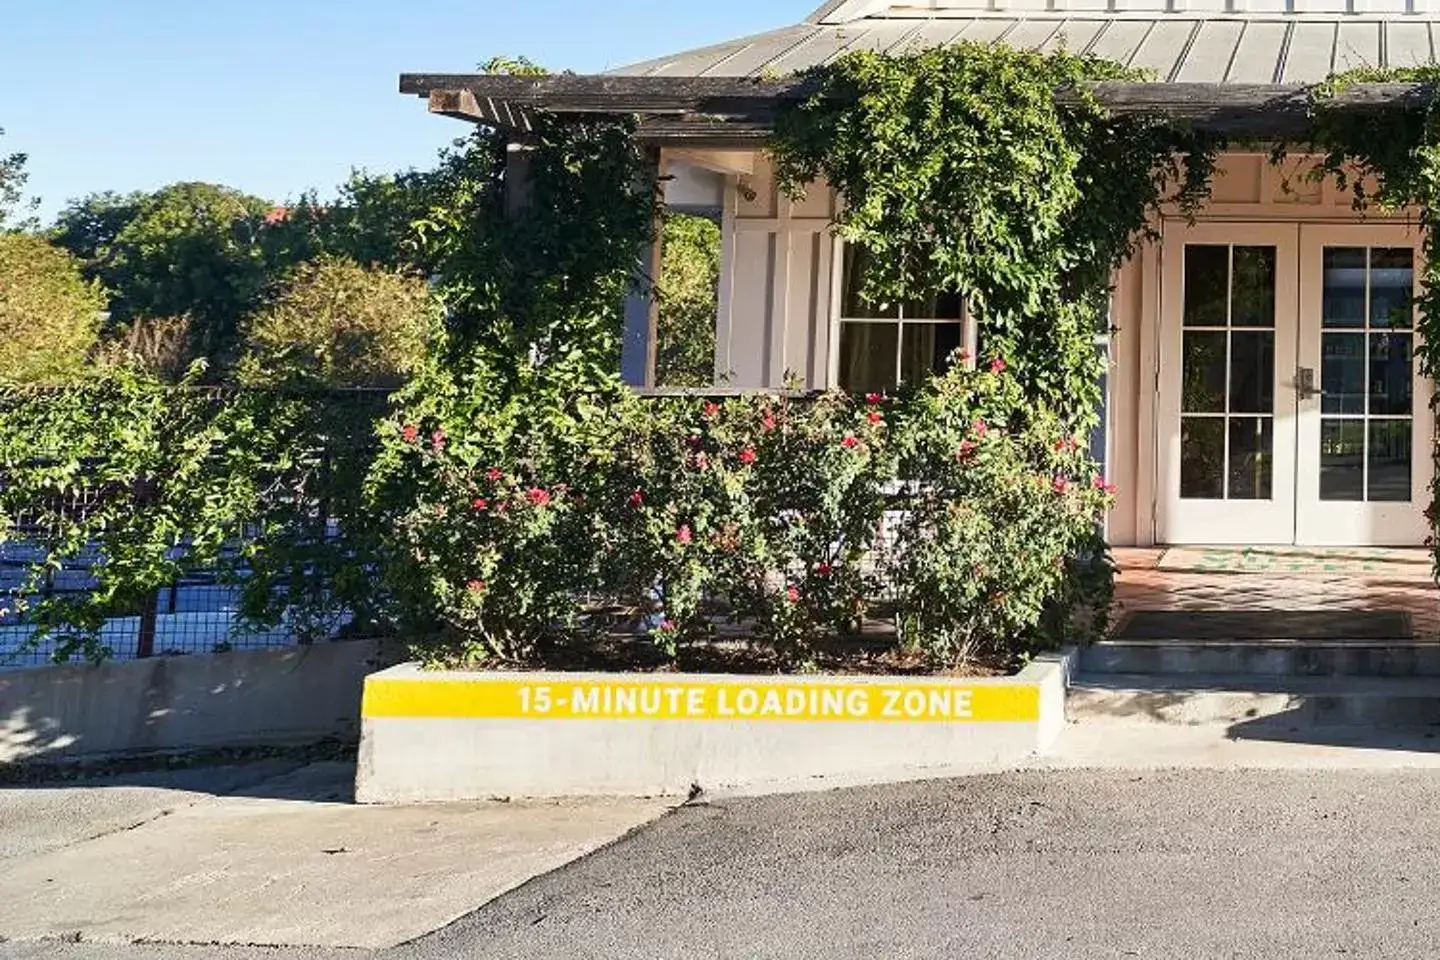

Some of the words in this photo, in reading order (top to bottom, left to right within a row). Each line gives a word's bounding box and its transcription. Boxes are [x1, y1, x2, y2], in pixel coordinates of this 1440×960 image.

[517, 687, 706, 715] 15-MINUTE
[716, 688, 869, 717] LOADING
[881, 690, 974, 718] ZONE
